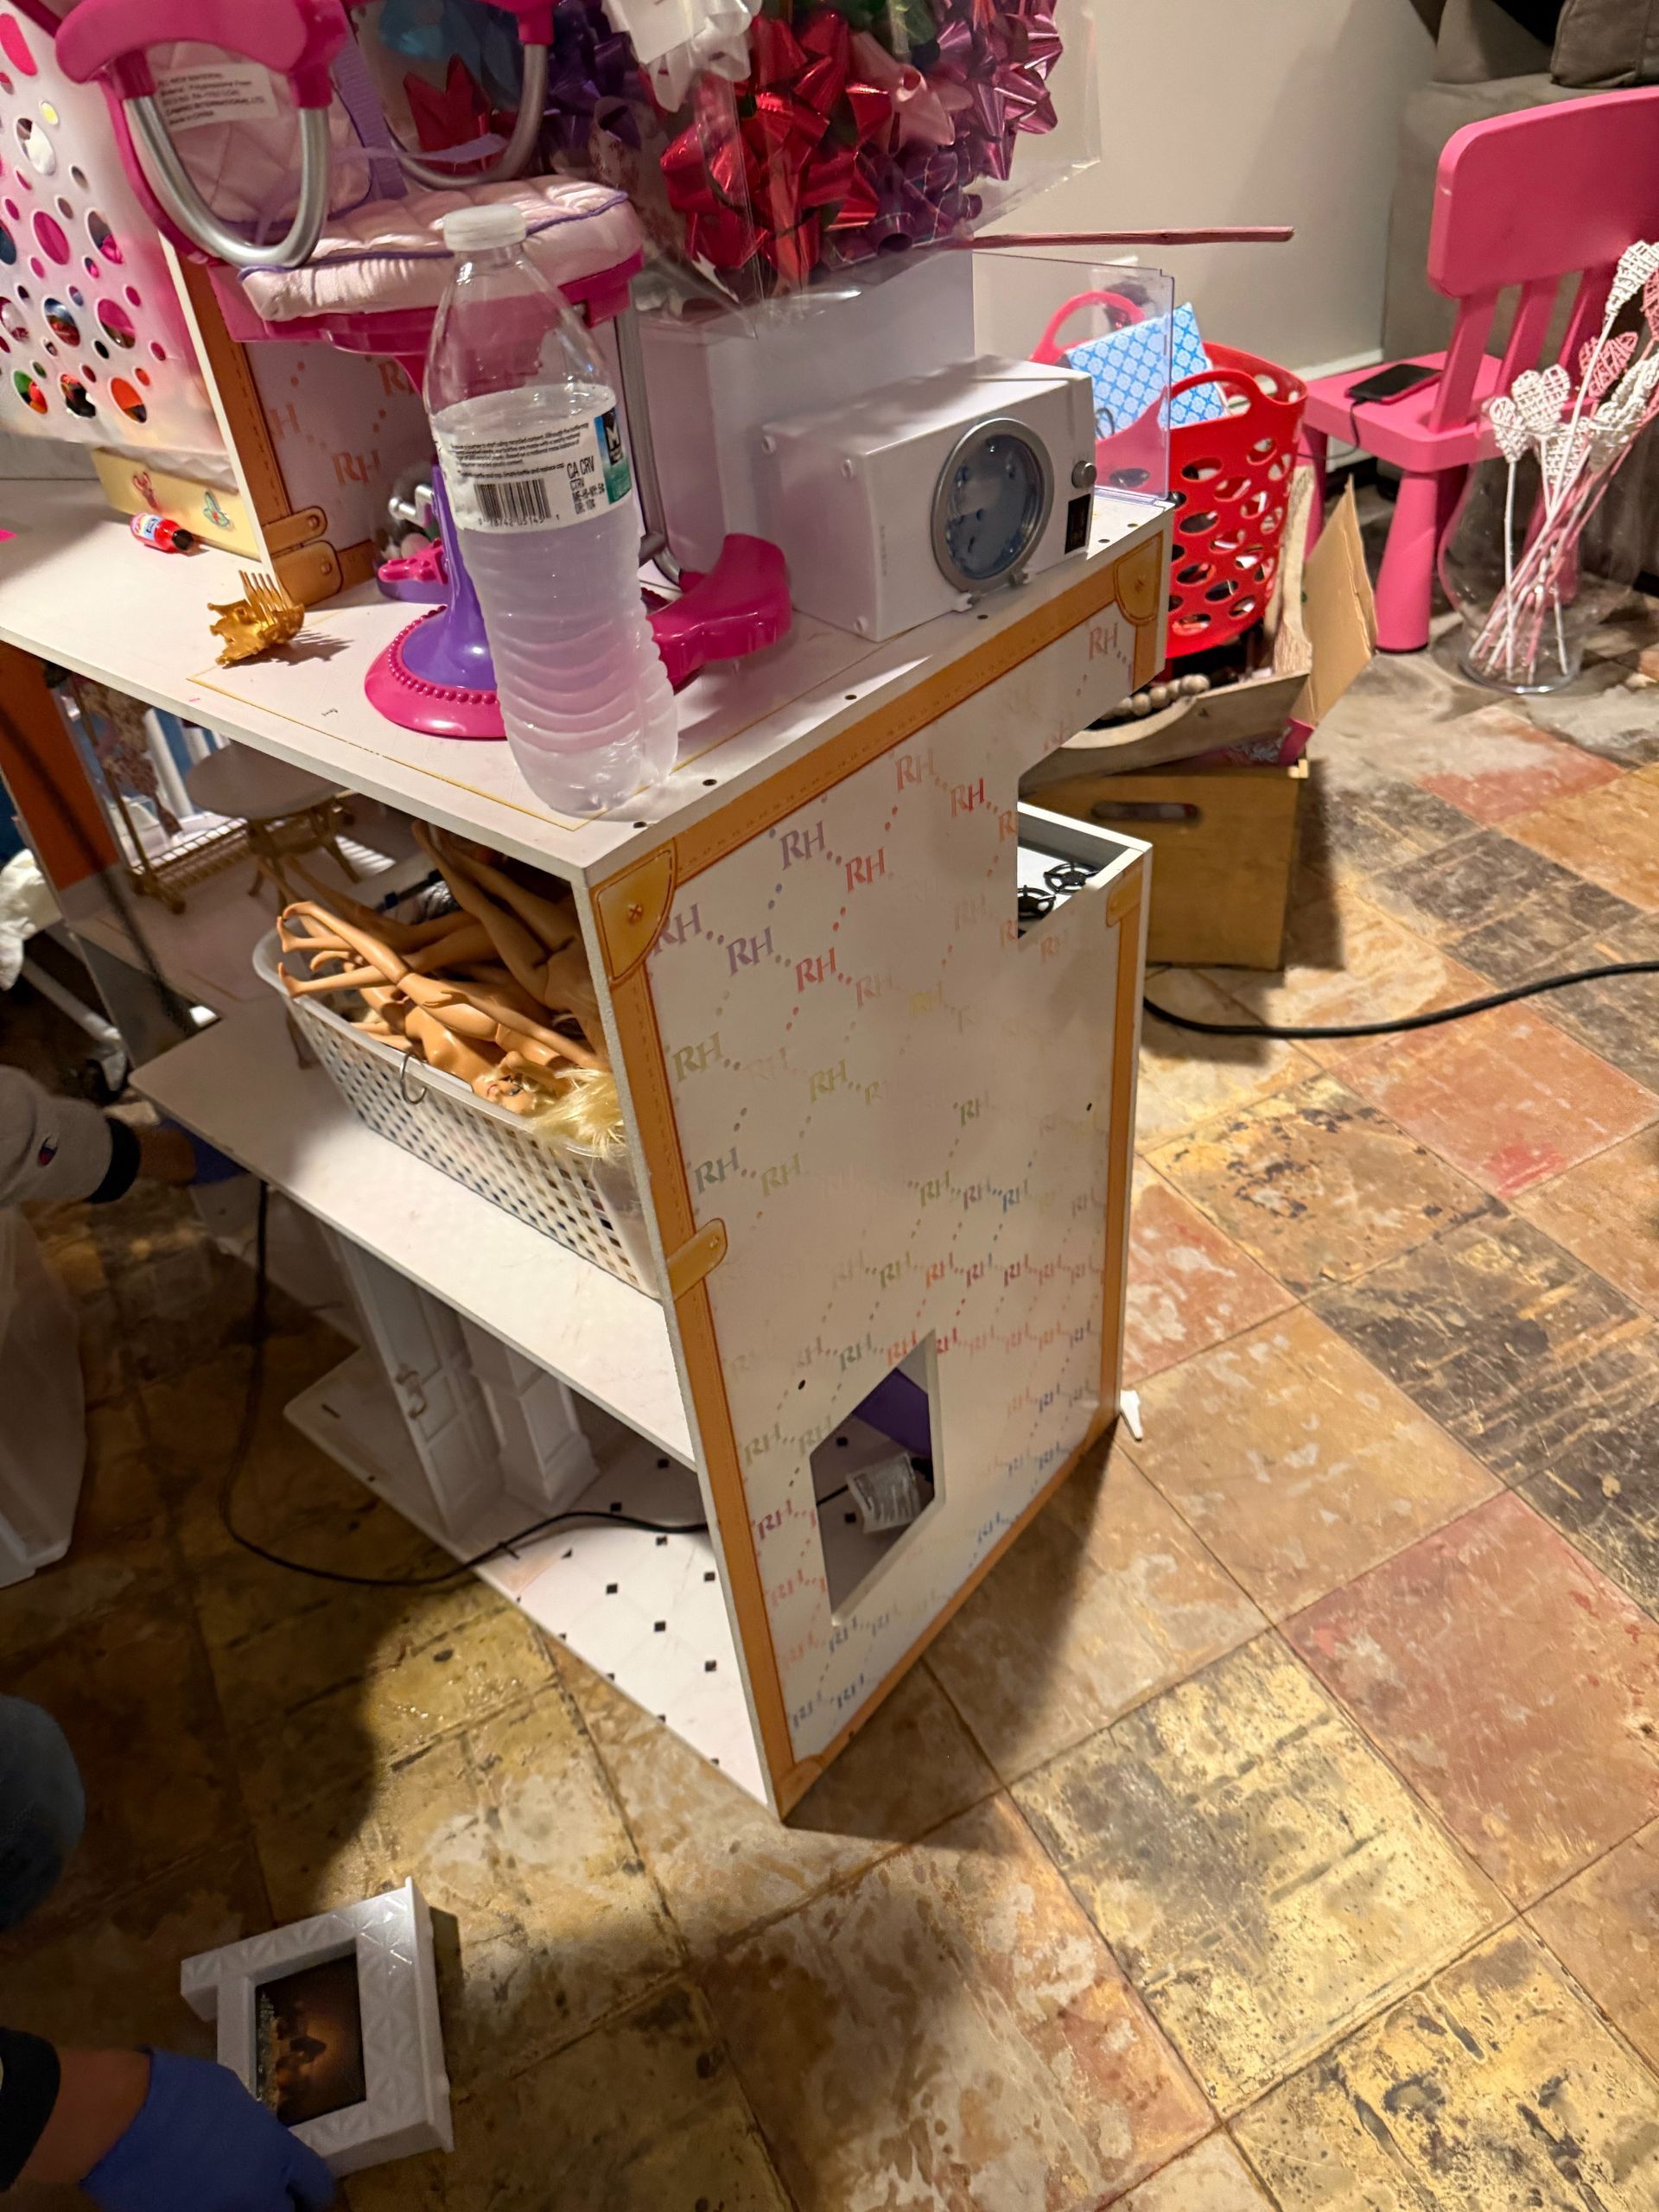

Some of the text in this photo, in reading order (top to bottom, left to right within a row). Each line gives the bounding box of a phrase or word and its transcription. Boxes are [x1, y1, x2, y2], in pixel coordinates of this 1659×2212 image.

[332, 449, 382, 485] RH
[567, 461, 580, 480] CA
[579, 454, 594, 475] CRV
[1088, 621, 1119, 662] RH
[895, 747, 935, 791] RH
[950, 777, 985, 817] RH
[779, 821, 825, 871] RH
[844, 845, 887, 894] RH
[726, 925, 775, 977] RH
[793, 945, 837, 995] RH
[671, 1031, 724, 1085] RH
[808, 1058, 849, 1104] RH
[694, 1145, 802, 1198] RH RH
[919, 1168, 950, 1210] RH
[963, 1175, 992, 1212] RH
[1002, 1177, 1030, 1216] RH
[879, 1250, 911, 1291] RH
[925, 1251, 954, 1290] RH
[966, 1252, 993, 1289] RH
[1004, 1252, 1030, 1288] RH
[838, 1331, 872, 1372] RH
[743, 1421, 782, 1467] RH
[758, 1497, 794, 1541] RH
